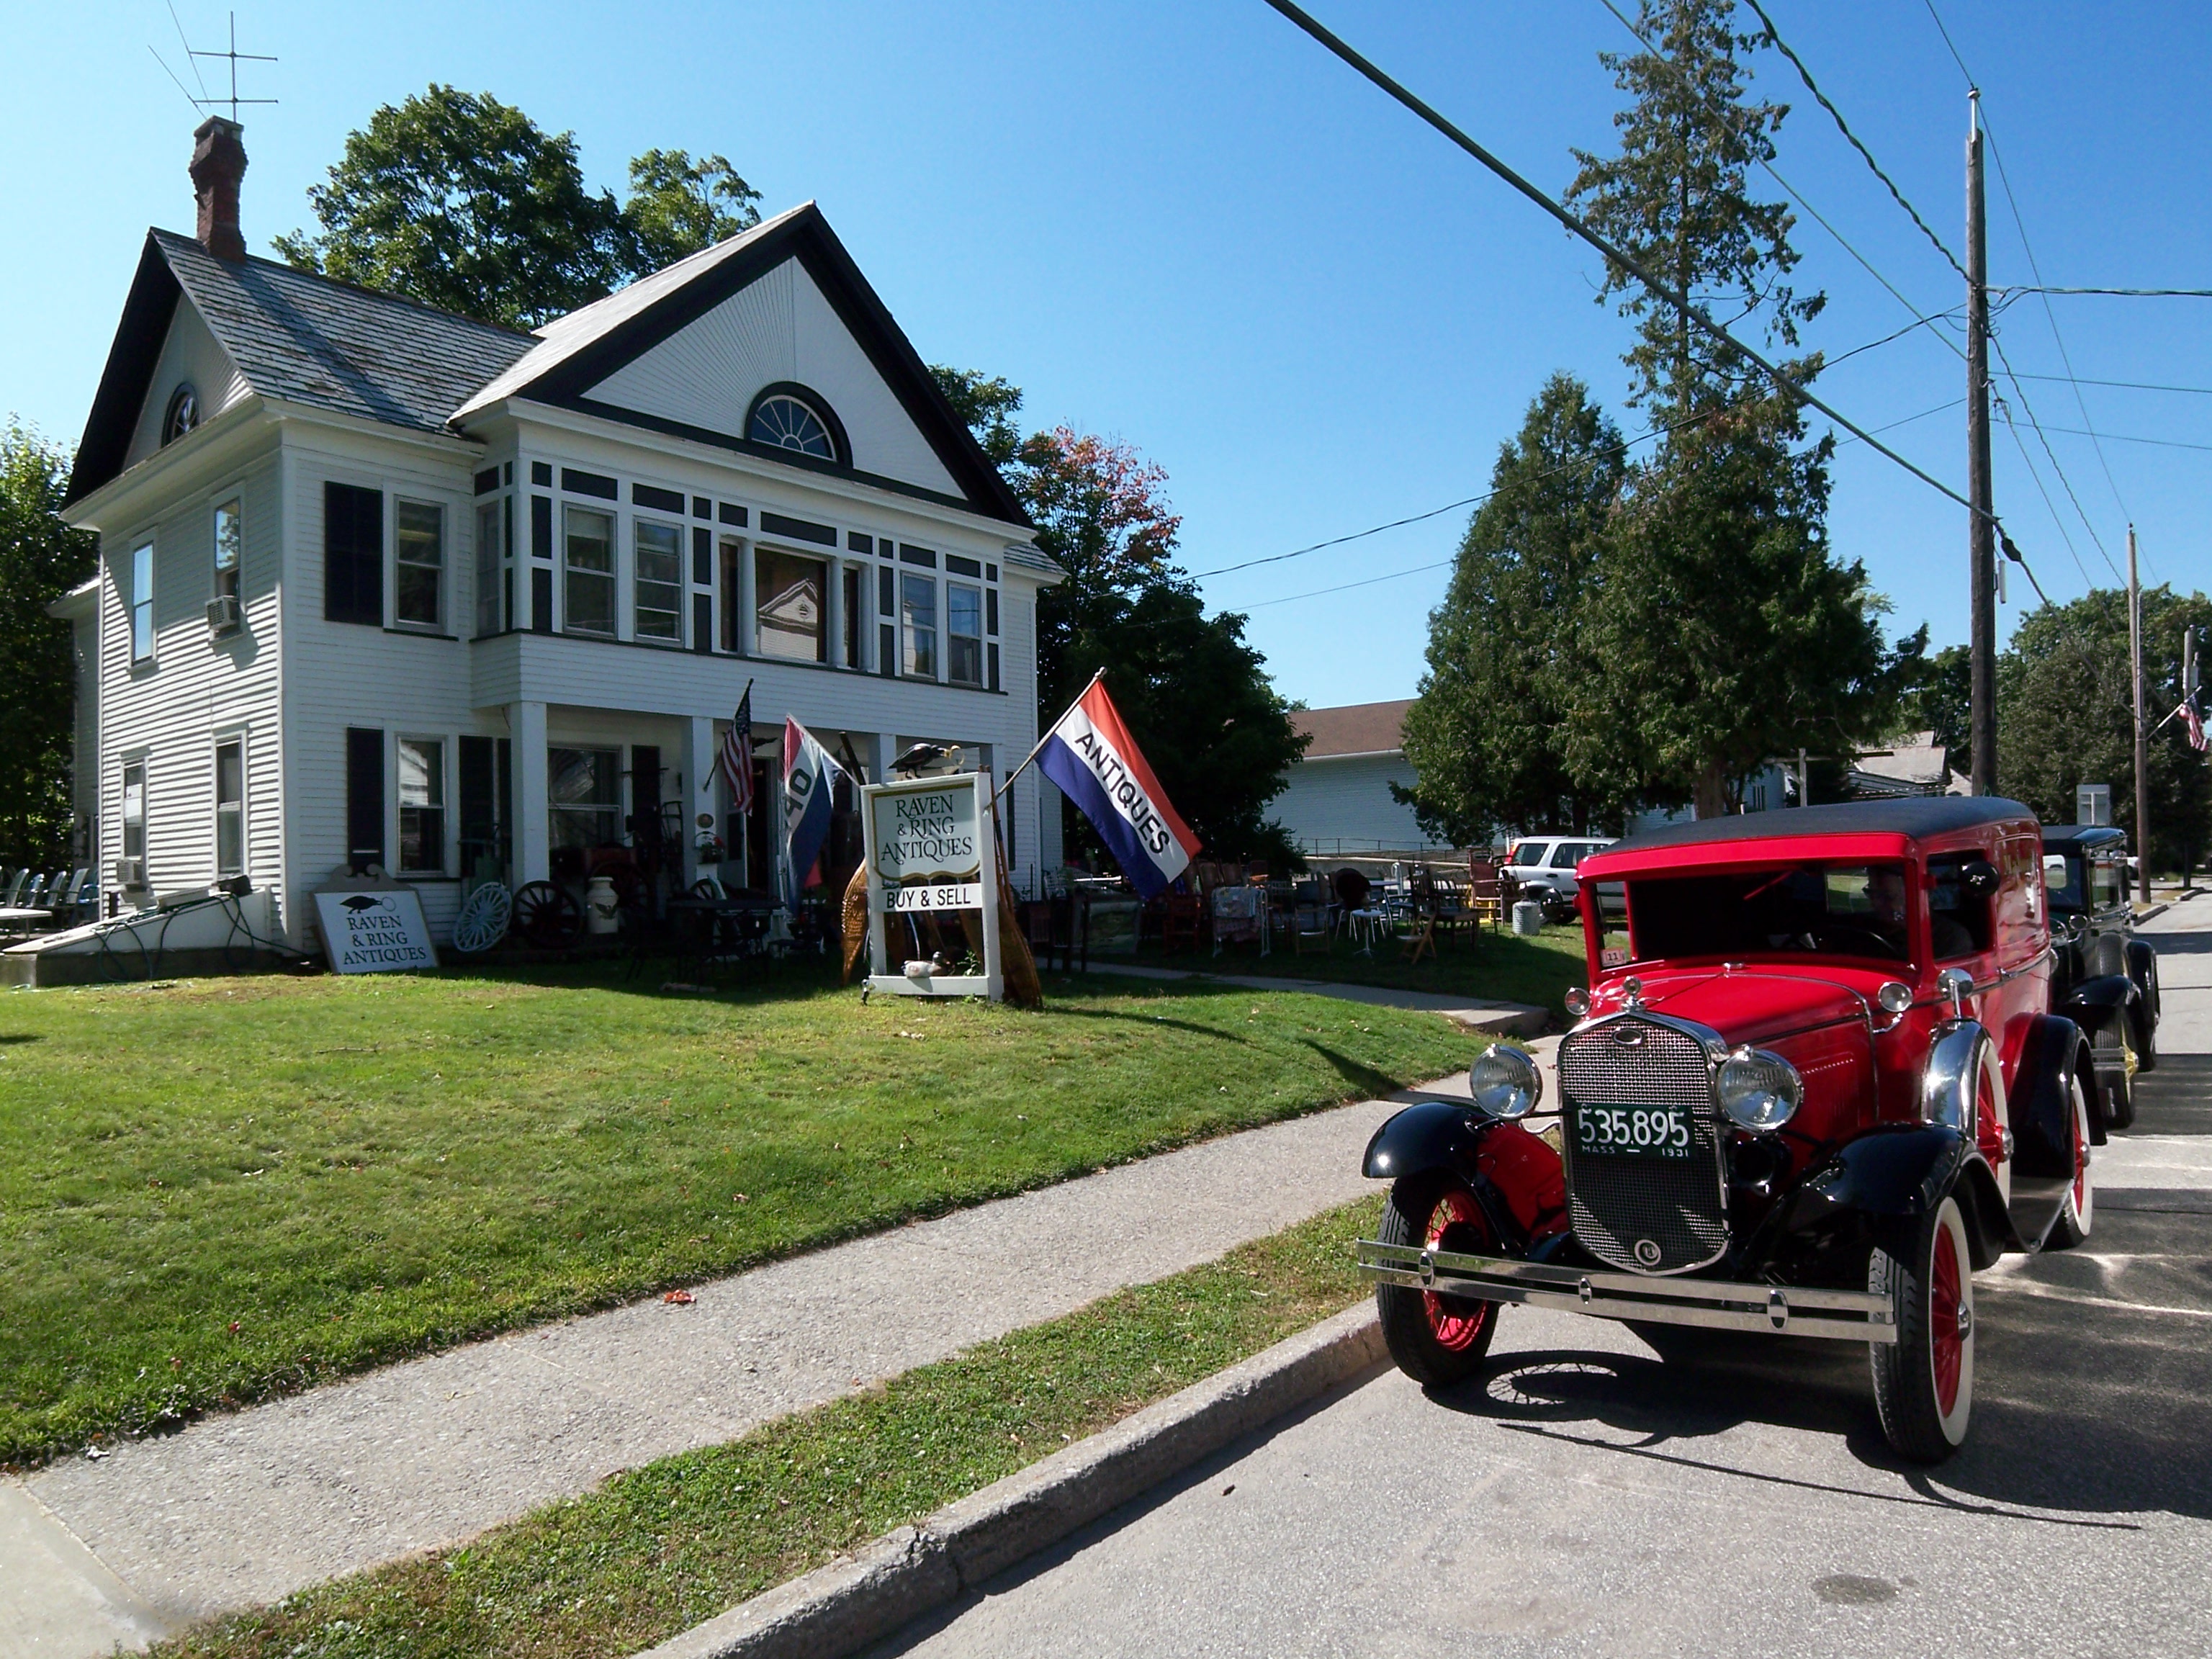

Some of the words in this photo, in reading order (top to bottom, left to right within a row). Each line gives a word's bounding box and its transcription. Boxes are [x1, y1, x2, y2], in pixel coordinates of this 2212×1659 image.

[1074, 732, 1170, 854] ANTIQUES
[895, 794, 953, 819] RAVEN
[897, 823, 907, 836] &
[909, 816, 955, 840] RING
[881, 837, 972, 865] ANTIQUES
[886, 890, 914, 909] BUY
[920, 890, 930, 907] &
[938, 888, 971, 906] SELL
[346, 915, 402, 930] RAVEN
[352, 934, 364, 947] &
[365, 932, 408, 945] RING
[343, 947, 426, 965] ANTIQUES
[1582, 1145, 1616, 1154] MASS
[1662, 1148, 1689, 1157] 1931
